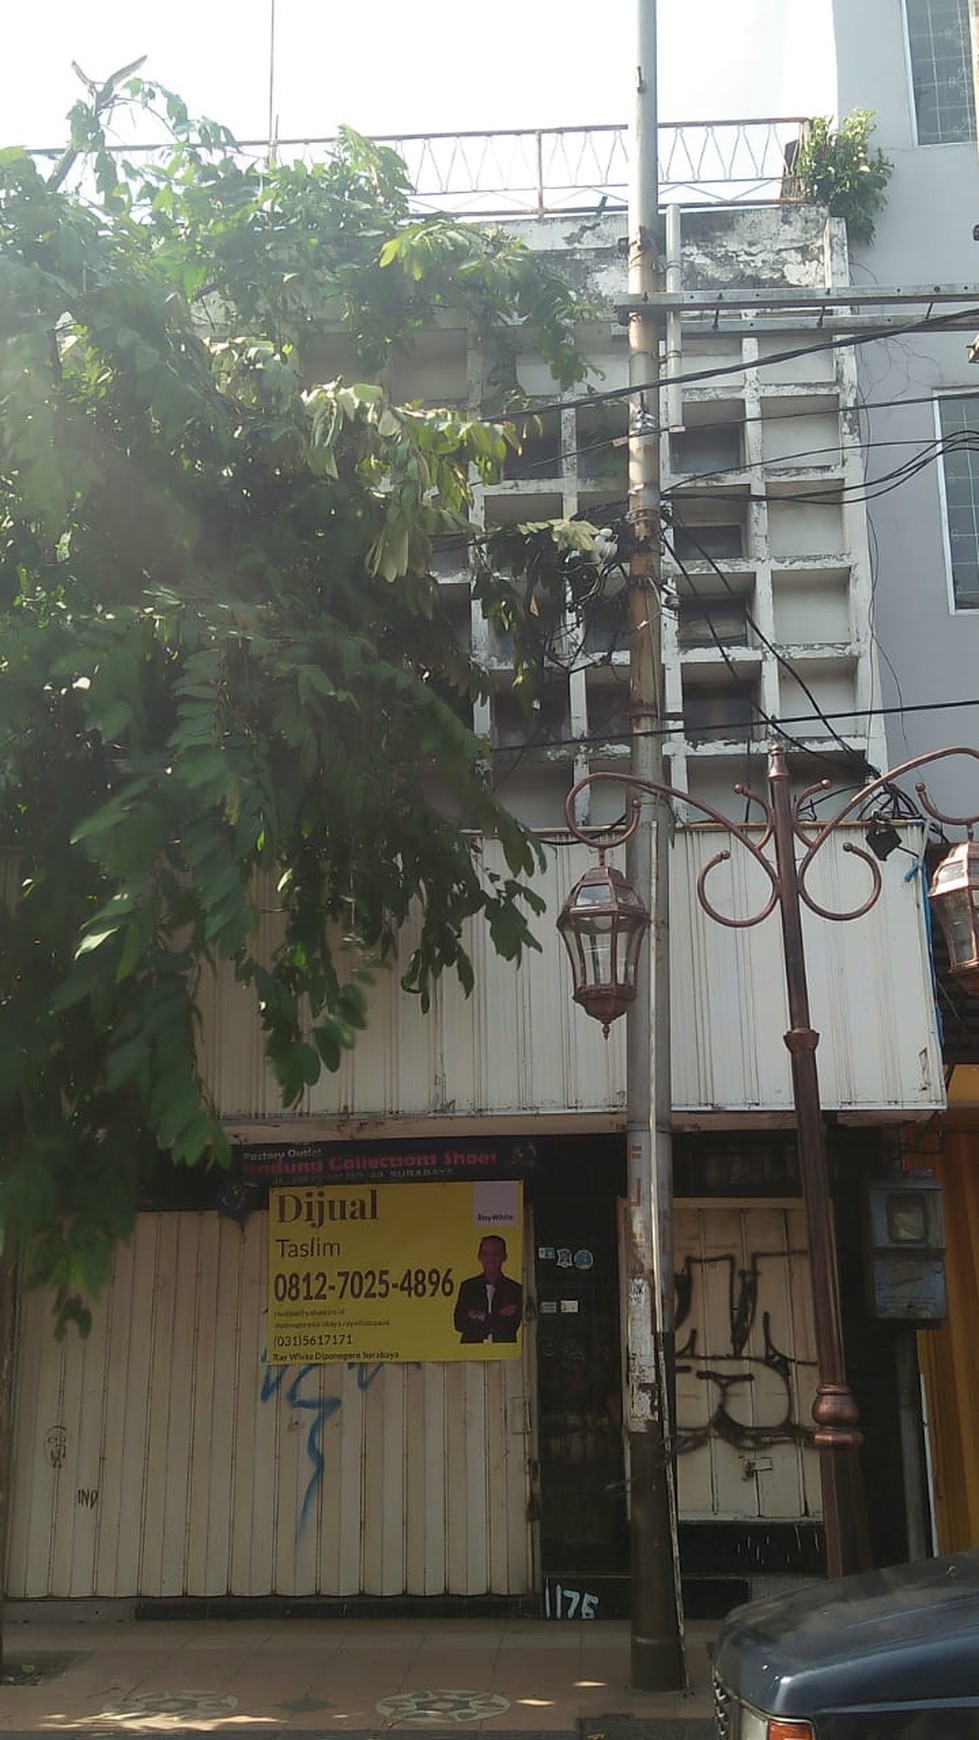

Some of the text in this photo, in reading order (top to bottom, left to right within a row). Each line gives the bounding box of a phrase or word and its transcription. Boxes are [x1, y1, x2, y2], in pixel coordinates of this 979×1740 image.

[275, 1189, 379, 1229] Dijual
[275, 1237, 341, 1258] Taslim
[274, 1268, 455, 1302] 0812-7025-4896
[273, 1334, 354, 1348] (031)5617171
